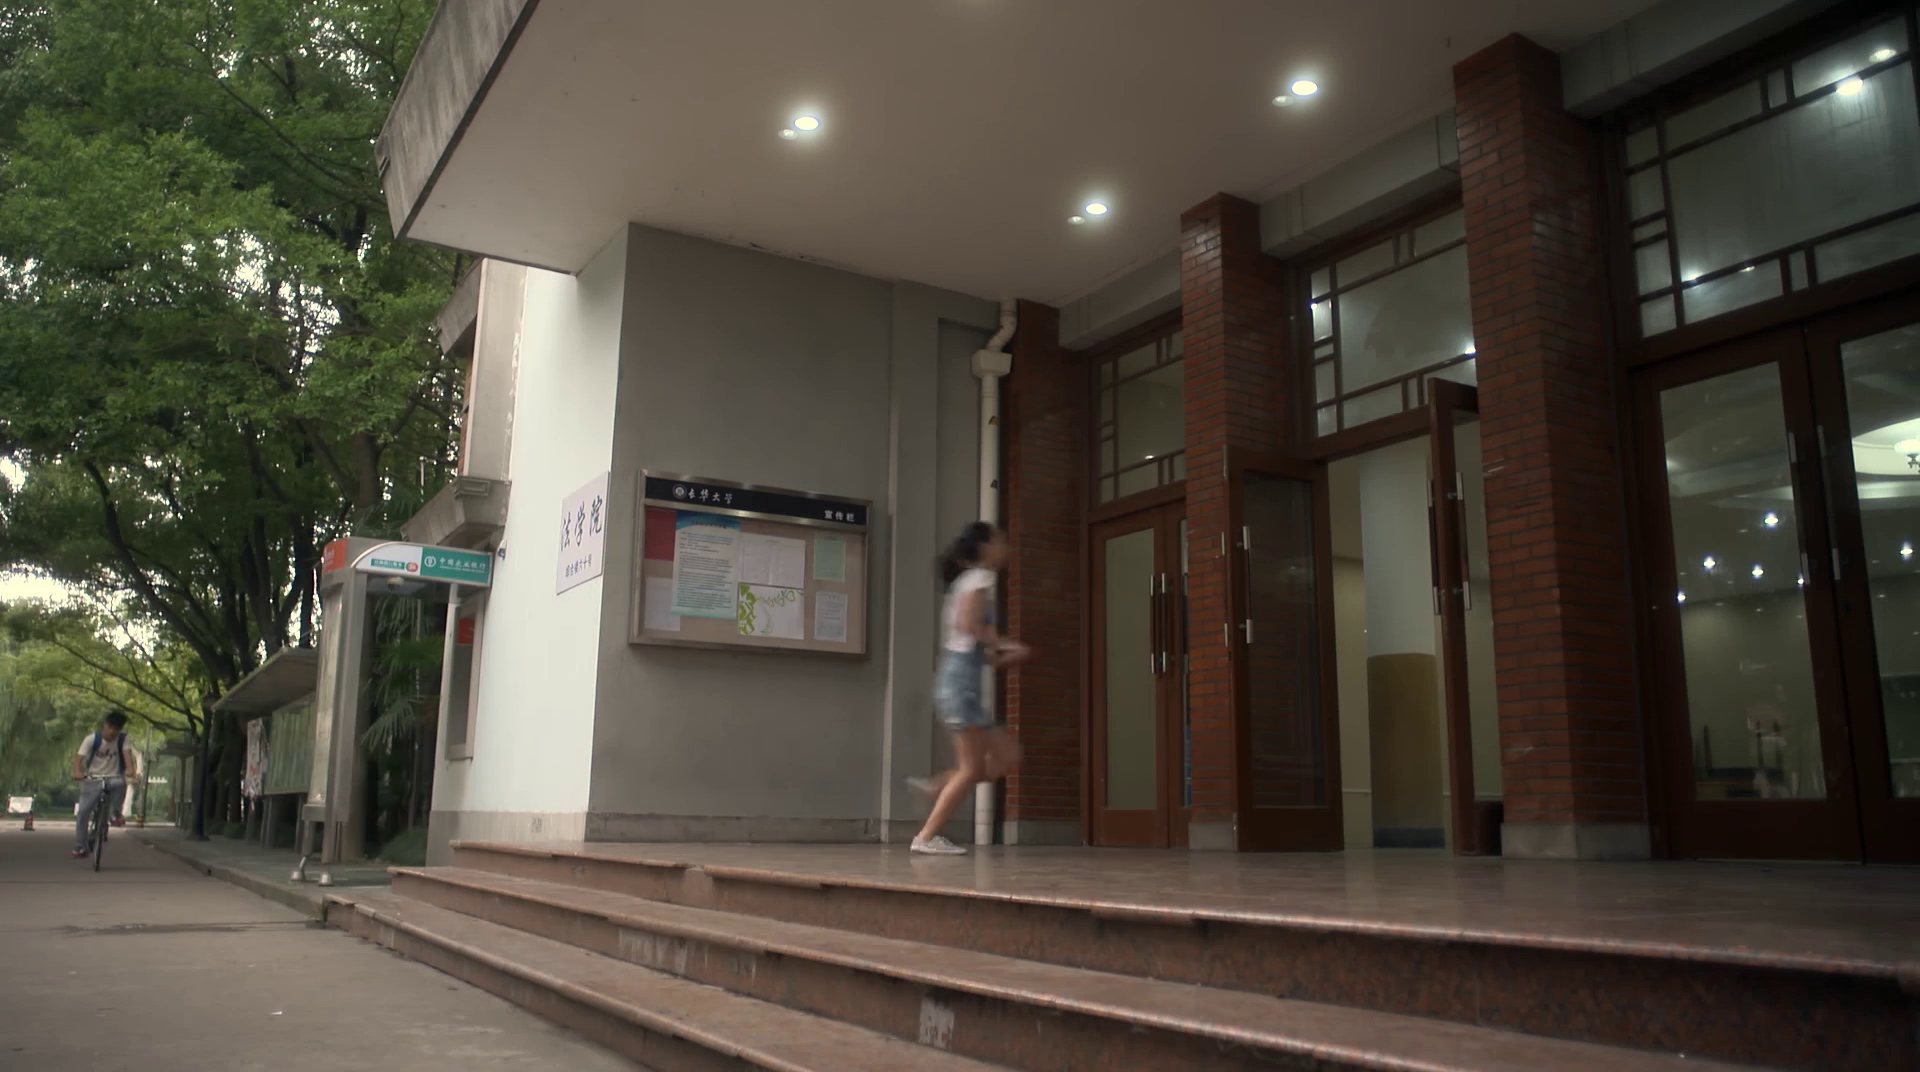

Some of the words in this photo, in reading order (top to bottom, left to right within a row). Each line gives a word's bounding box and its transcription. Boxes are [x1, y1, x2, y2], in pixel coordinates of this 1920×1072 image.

[561, 494, 603, 551] 法学院
[824, 510, 854, 522] 宣传栏
